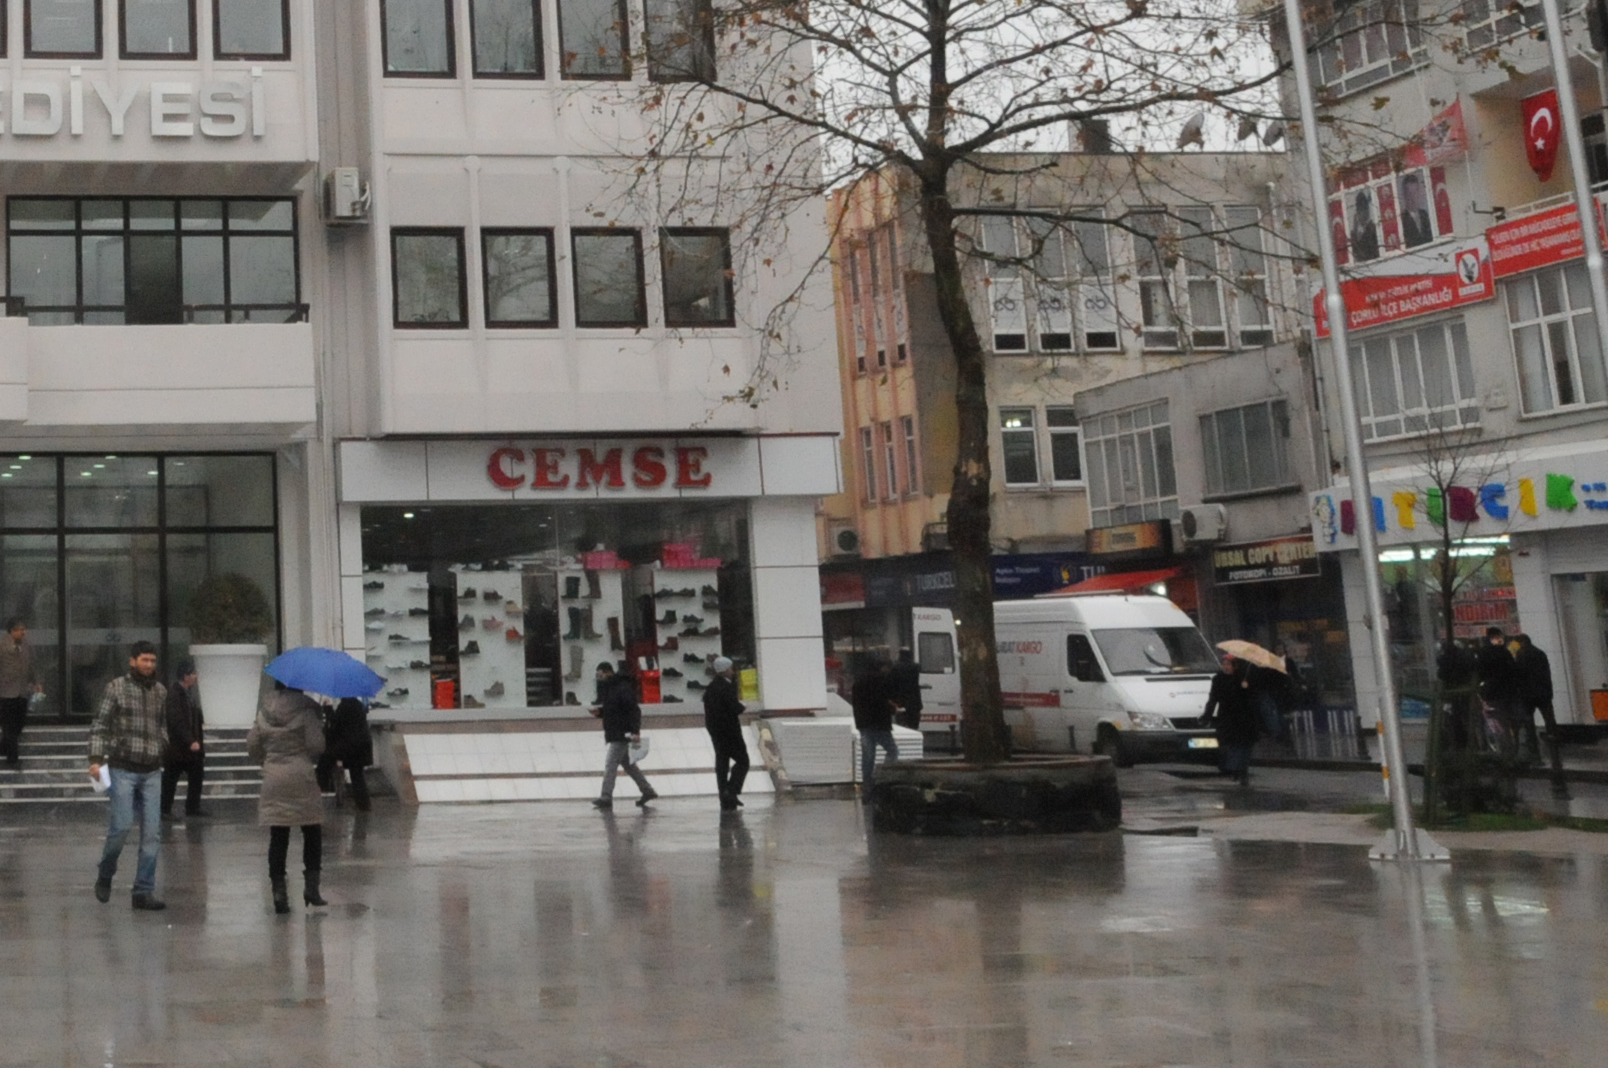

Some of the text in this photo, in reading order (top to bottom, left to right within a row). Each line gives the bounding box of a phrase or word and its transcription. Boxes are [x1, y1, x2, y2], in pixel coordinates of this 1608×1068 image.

[1380, 301, 1398, 318] İLÇE
[1399, 286, 1453, 314] BAŞKANLIĞI
[486, 445, 713, 491] CEMSE
[915, 571, 958, 592] TURKCEL
